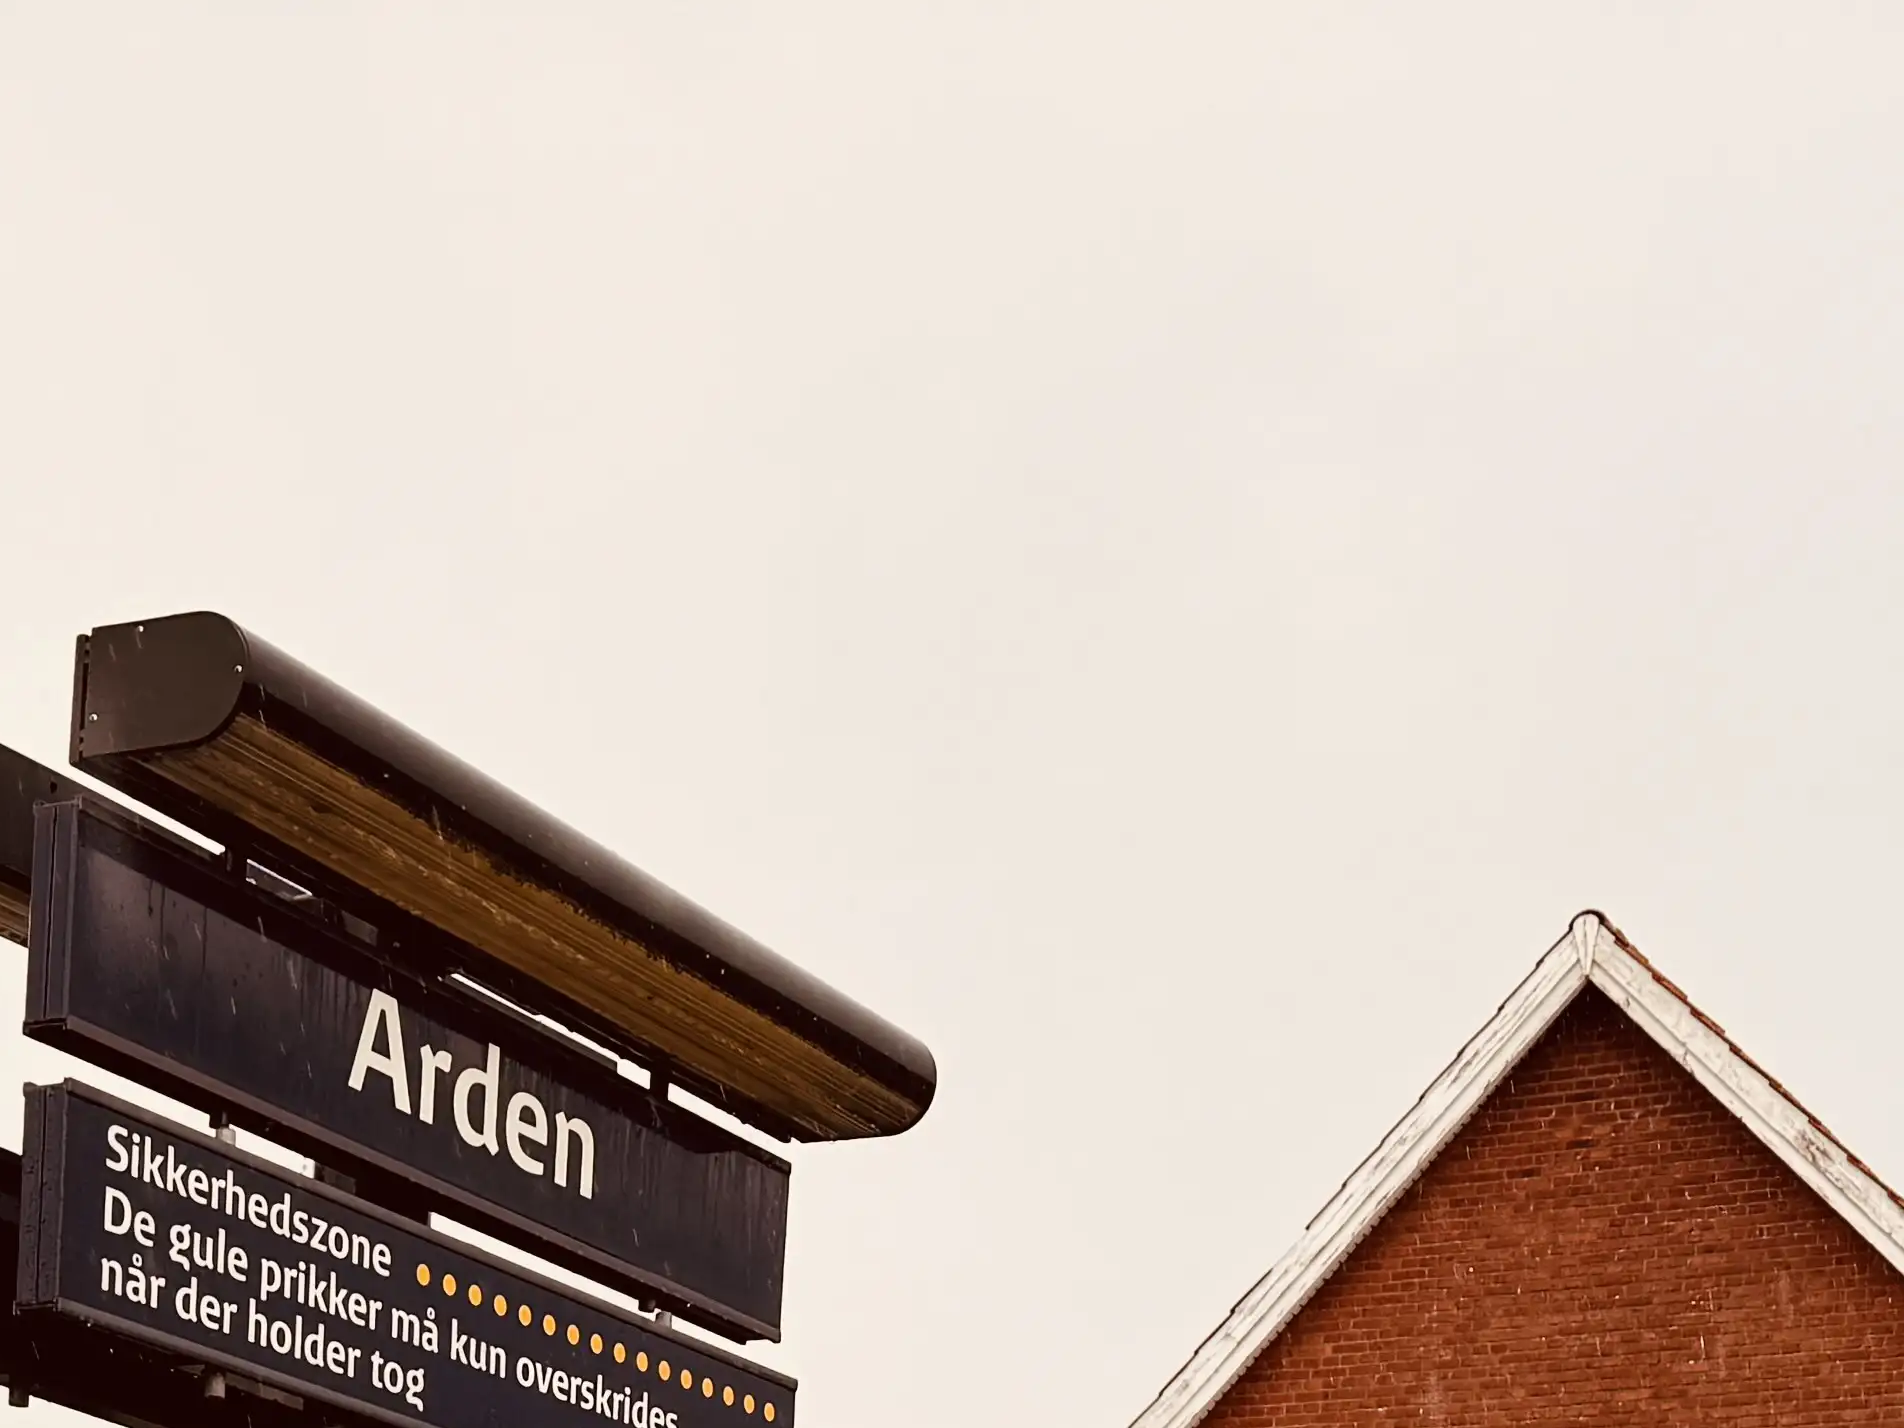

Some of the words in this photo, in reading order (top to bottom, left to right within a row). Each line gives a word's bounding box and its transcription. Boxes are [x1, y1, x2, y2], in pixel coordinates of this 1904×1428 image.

[348, 989, 594, 1199] Arden
[104, 1186, 155, 1247] De
[169, 1224, 247, 1281] gule
[261, 1259, 382, 1330] prikker
[392, 1308, 438, 1353] må
[451, 1319, 506, 1378] kun
[106, 1125, 391, 1276] Sikkerhedszone
[102, 1258, 165, 1309] når
[176, 1278, 237, 1334] der
[248, 1301, 361, 1377] holder
[371, 1351, 424, 1411] tog
